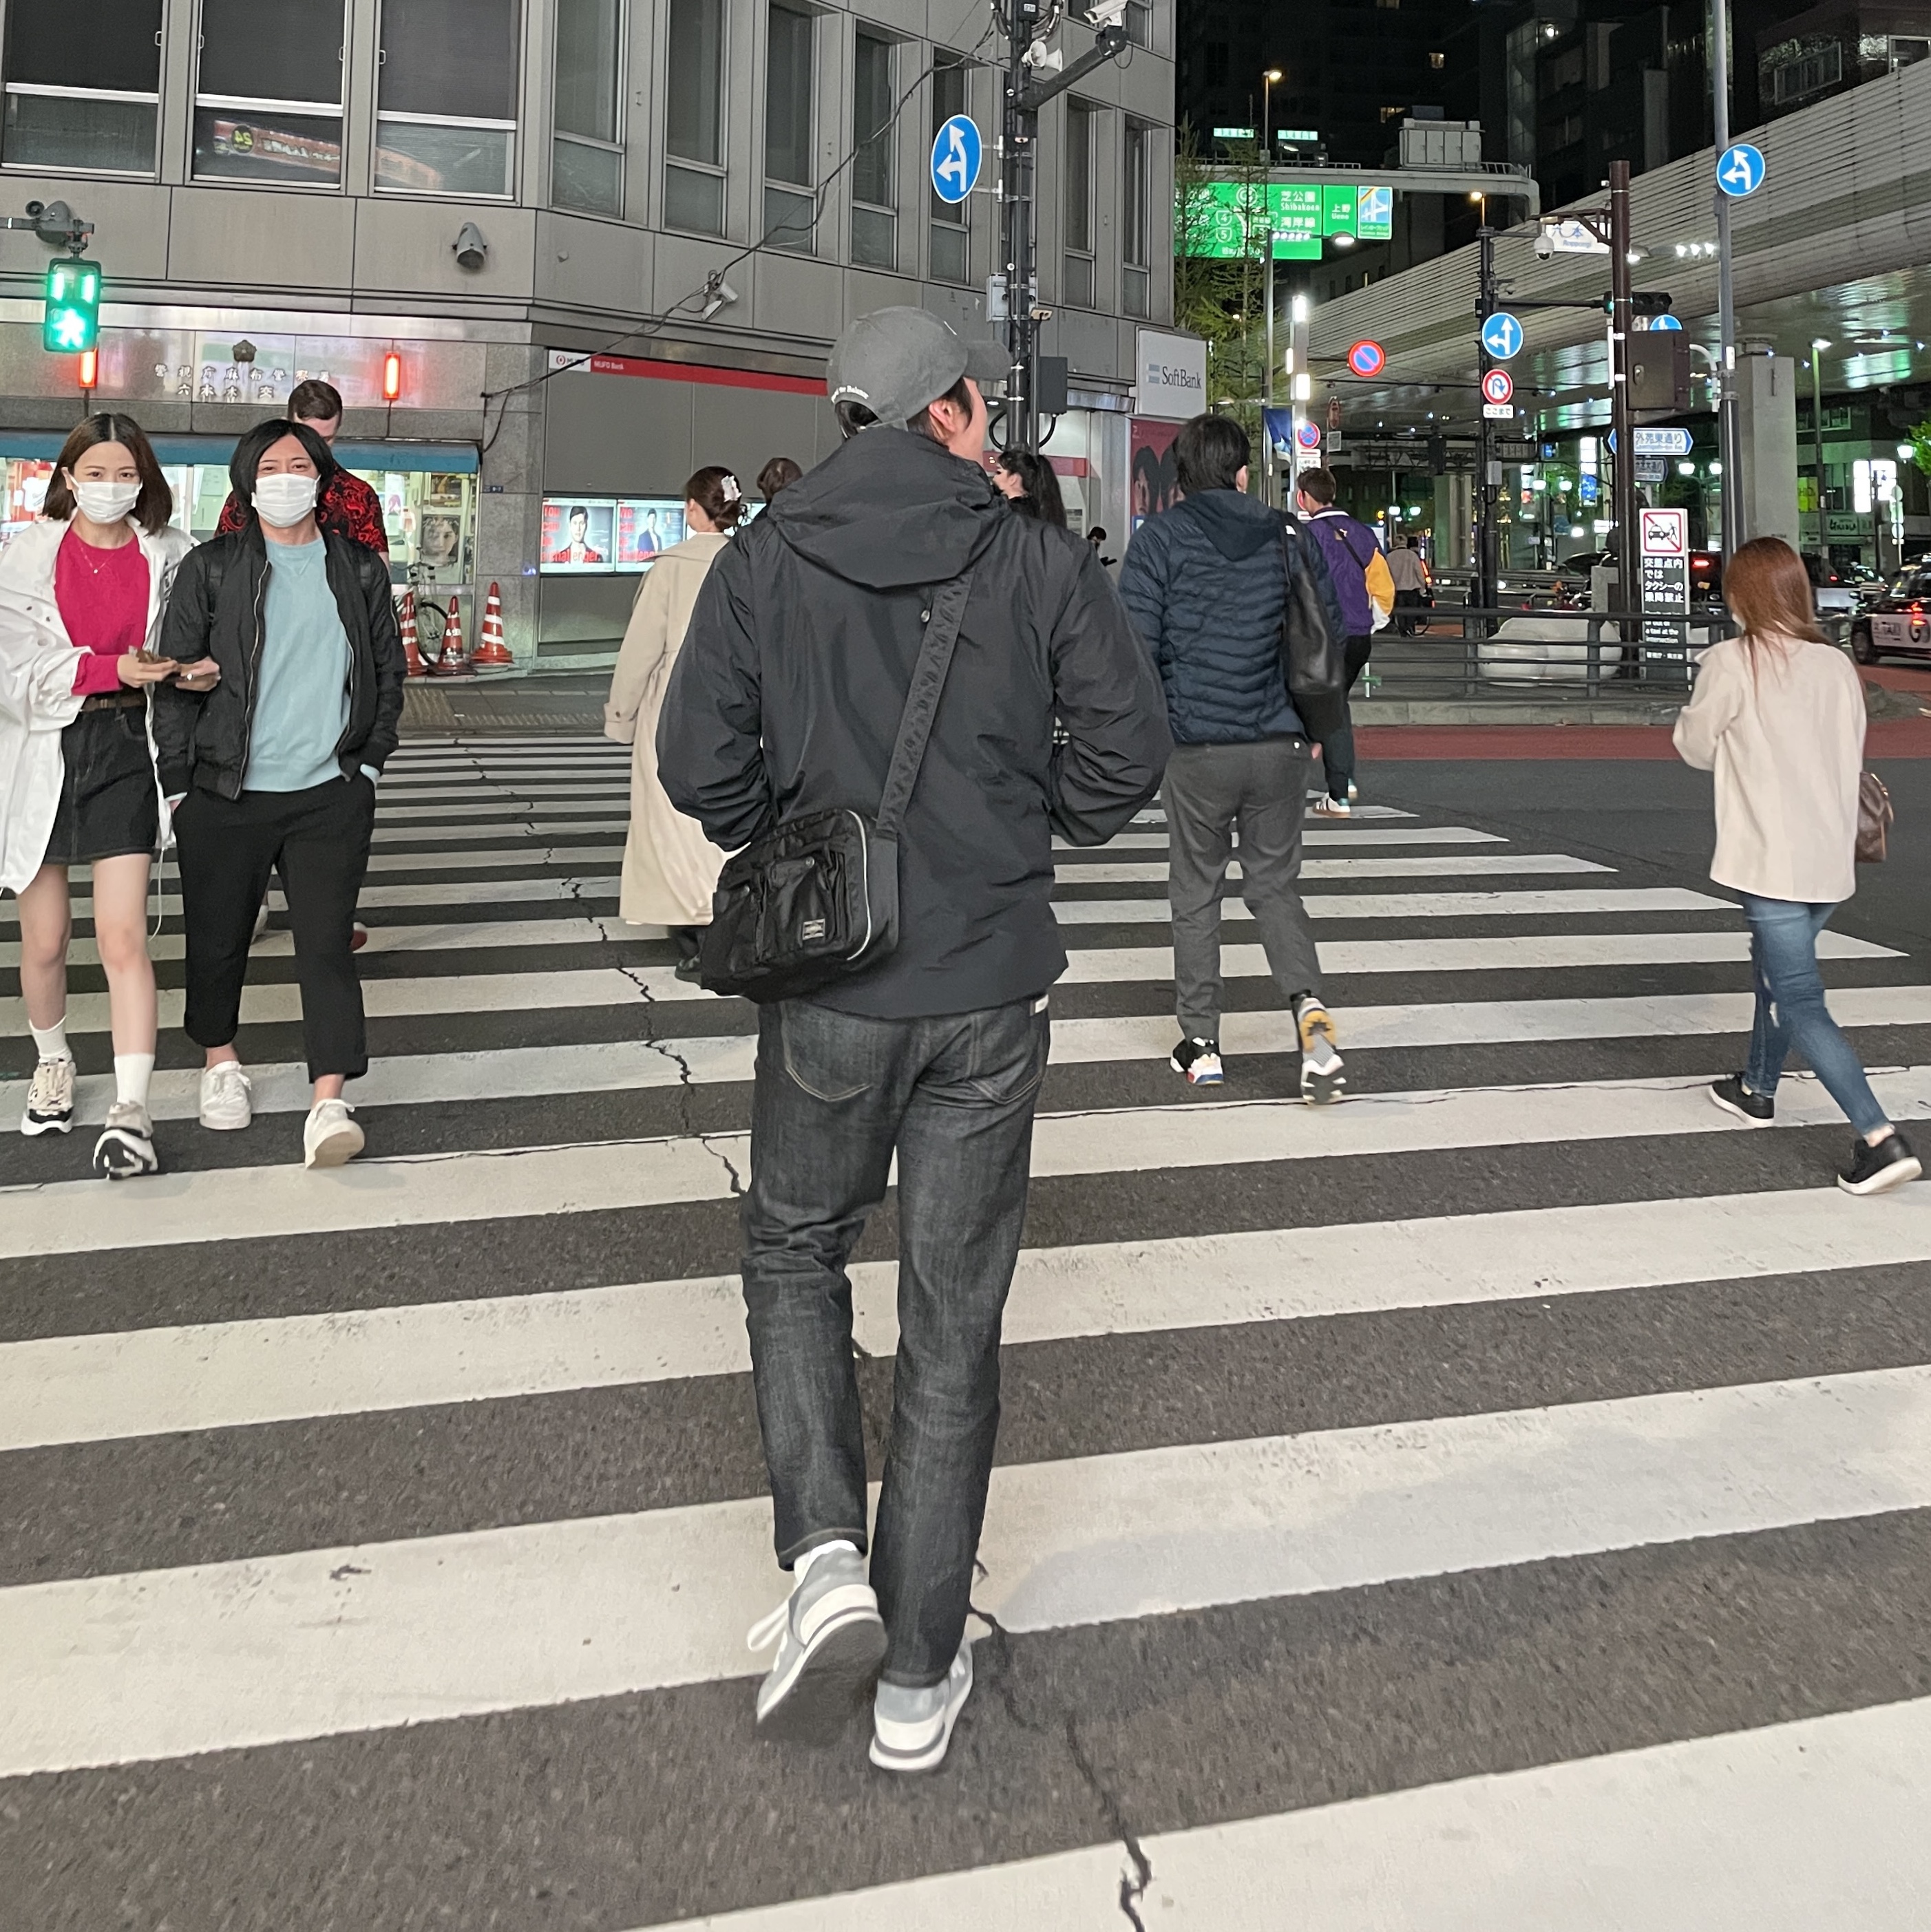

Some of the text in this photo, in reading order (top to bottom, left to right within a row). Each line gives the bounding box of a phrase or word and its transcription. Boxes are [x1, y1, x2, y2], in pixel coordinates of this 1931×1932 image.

[1281, 191, 1315, 202] 芝公園
[1281, 202, 1320, 211] Shibakoen
[1331, 204, 1351, 213] 上野
[1221, 230, 1228, 239] 5
[1161, 365, 1201, 390] SoftBank
[177, 383, 275, 399] 六本木交
[1636, 432, 1682, 444] 外苑東通り
[1644, 558, 1683, 569] 交差点内
[1645, 569, 1664, 579] では
[1645, 581, 1684, 591] タクシーの
[1645, 591, 1684, 603] 乗降禁止
